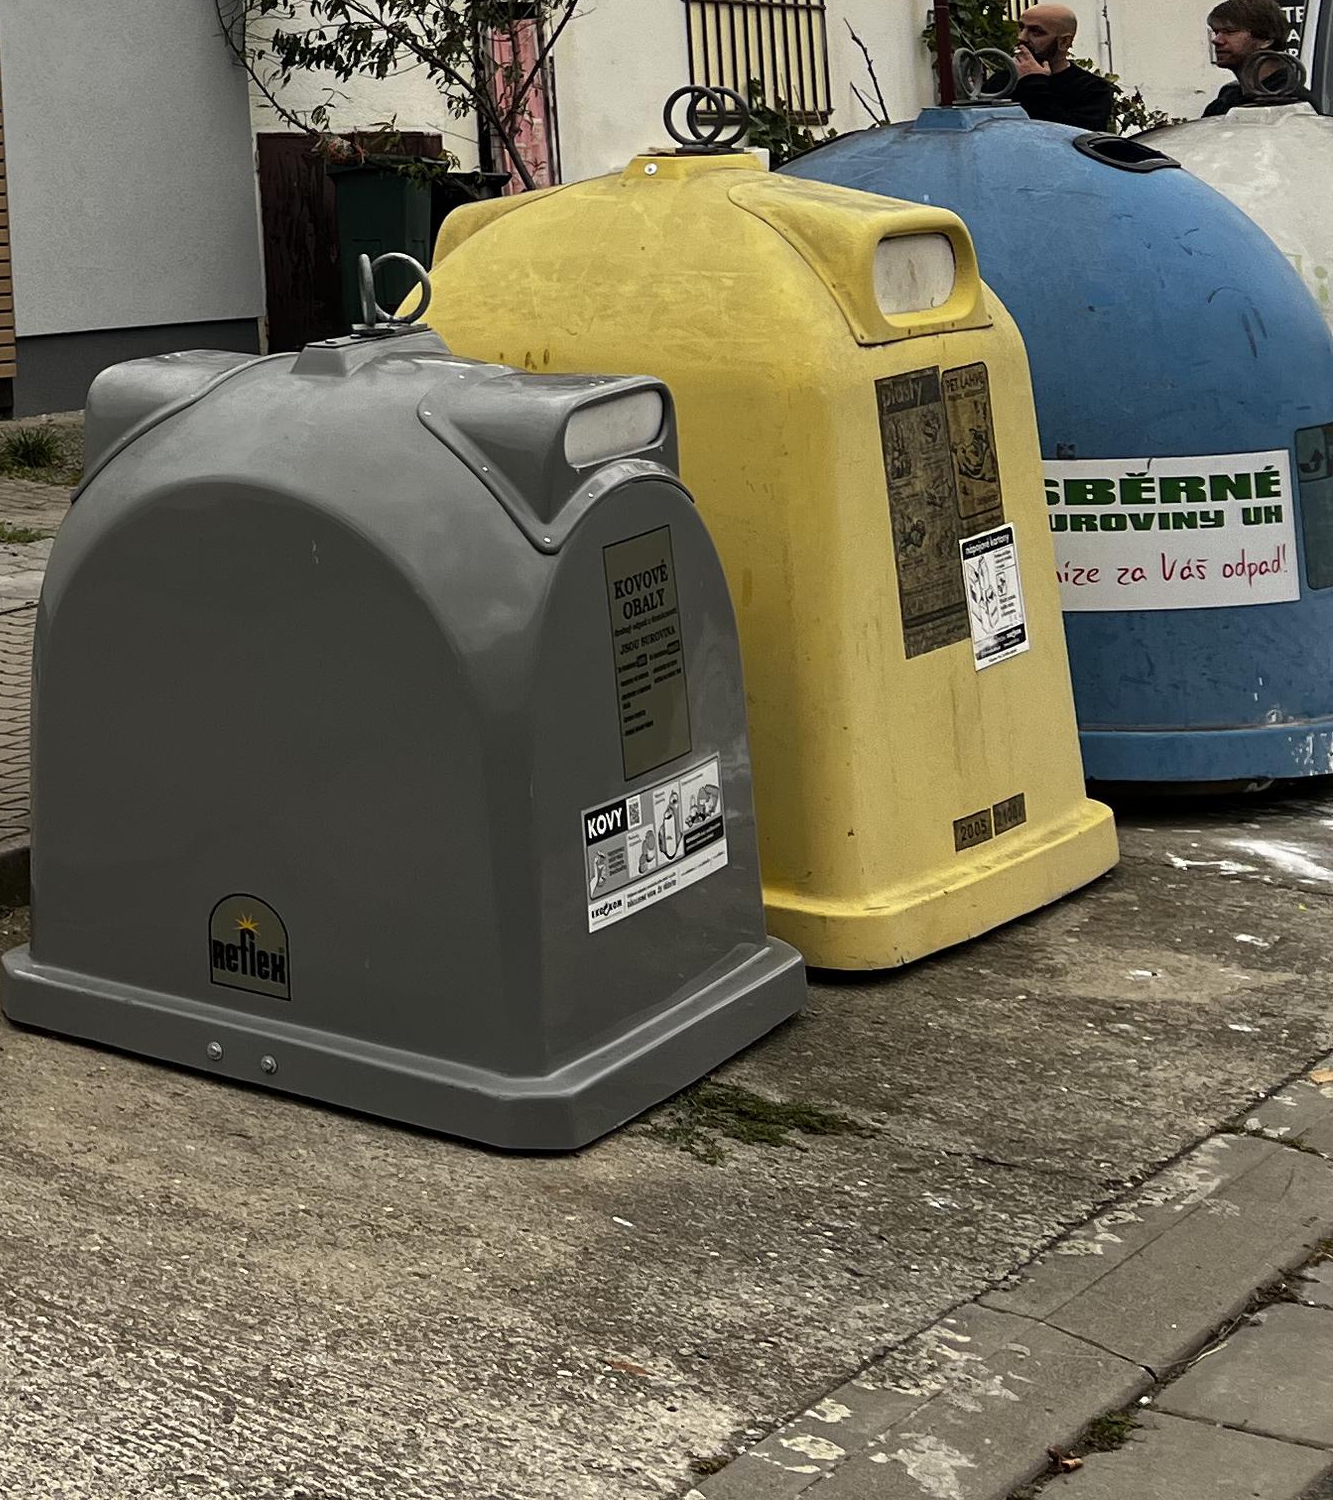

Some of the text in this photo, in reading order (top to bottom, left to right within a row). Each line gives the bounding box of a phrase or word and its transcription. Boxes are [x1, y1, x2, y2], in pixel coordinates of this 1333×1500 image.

[1049, 505, 1283, 533] UROVINY UH
[614, 559, 669, 600] KOVOVÉ
[1056, 543, 1288, 588] íze za Váš odpad!
[623, 588, 665, 620] OBALY
[587, 807, 623, 839] KOVY
[960, 819, 988, 841] 2005
